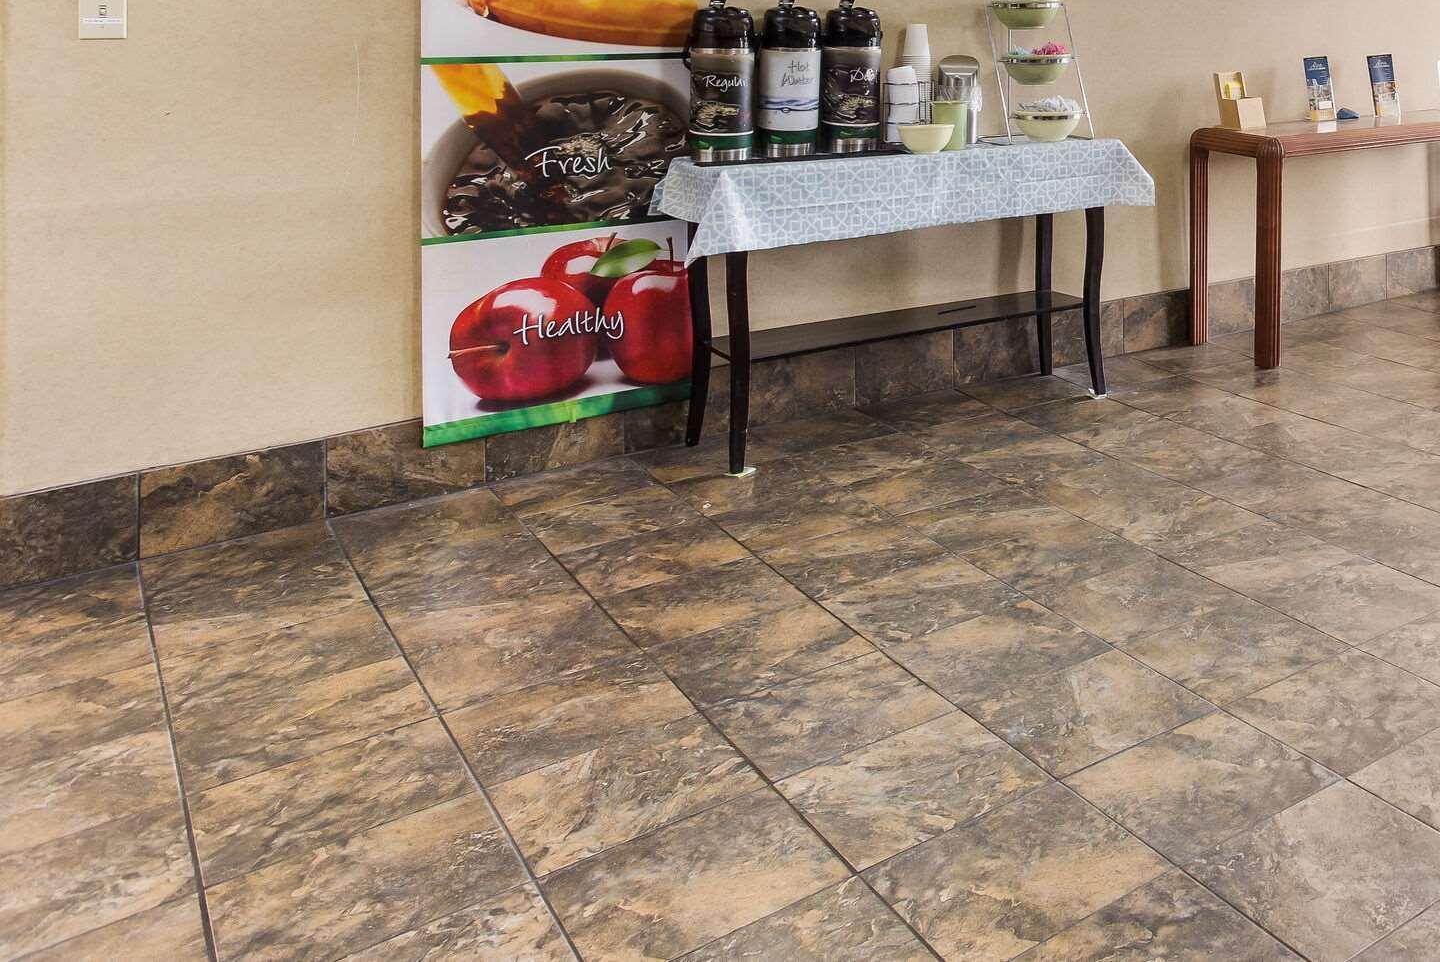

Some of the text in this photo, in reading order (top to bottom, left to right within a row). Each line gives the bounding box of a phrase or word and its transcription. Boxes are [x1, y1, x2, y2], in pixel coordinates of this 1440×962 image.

[702, 74, 749, 93] Regular
[524, 145, 613, 178] Fresh
[513, 307, 624, 345] Healthy
